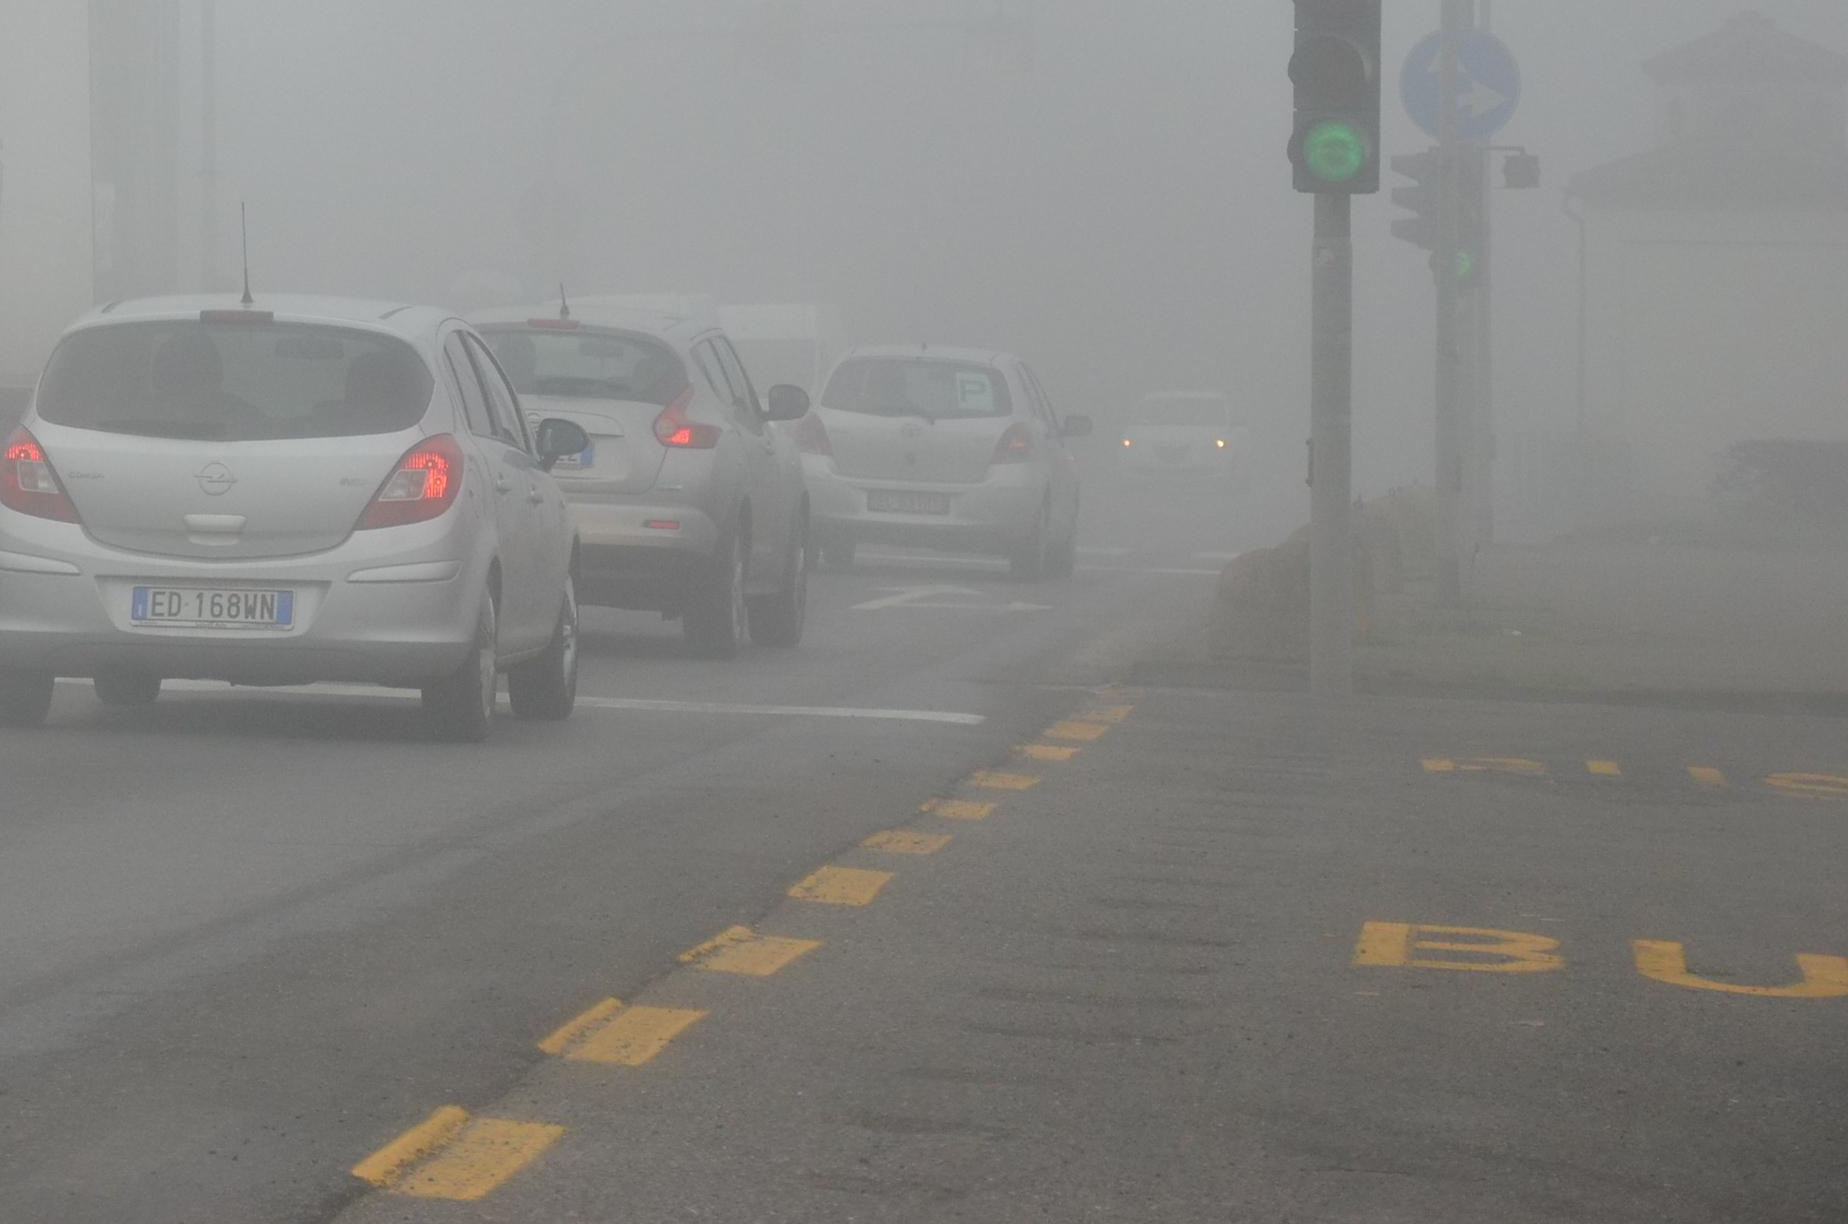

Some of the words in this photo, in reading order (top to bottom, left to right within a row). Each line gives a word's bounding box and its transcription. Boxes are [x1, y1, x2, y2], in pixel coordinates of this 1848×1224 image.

[959, 379, 986, 403] P
[151, 591, 181, 618] ED
[196, 591, 275, 620] 168WN
